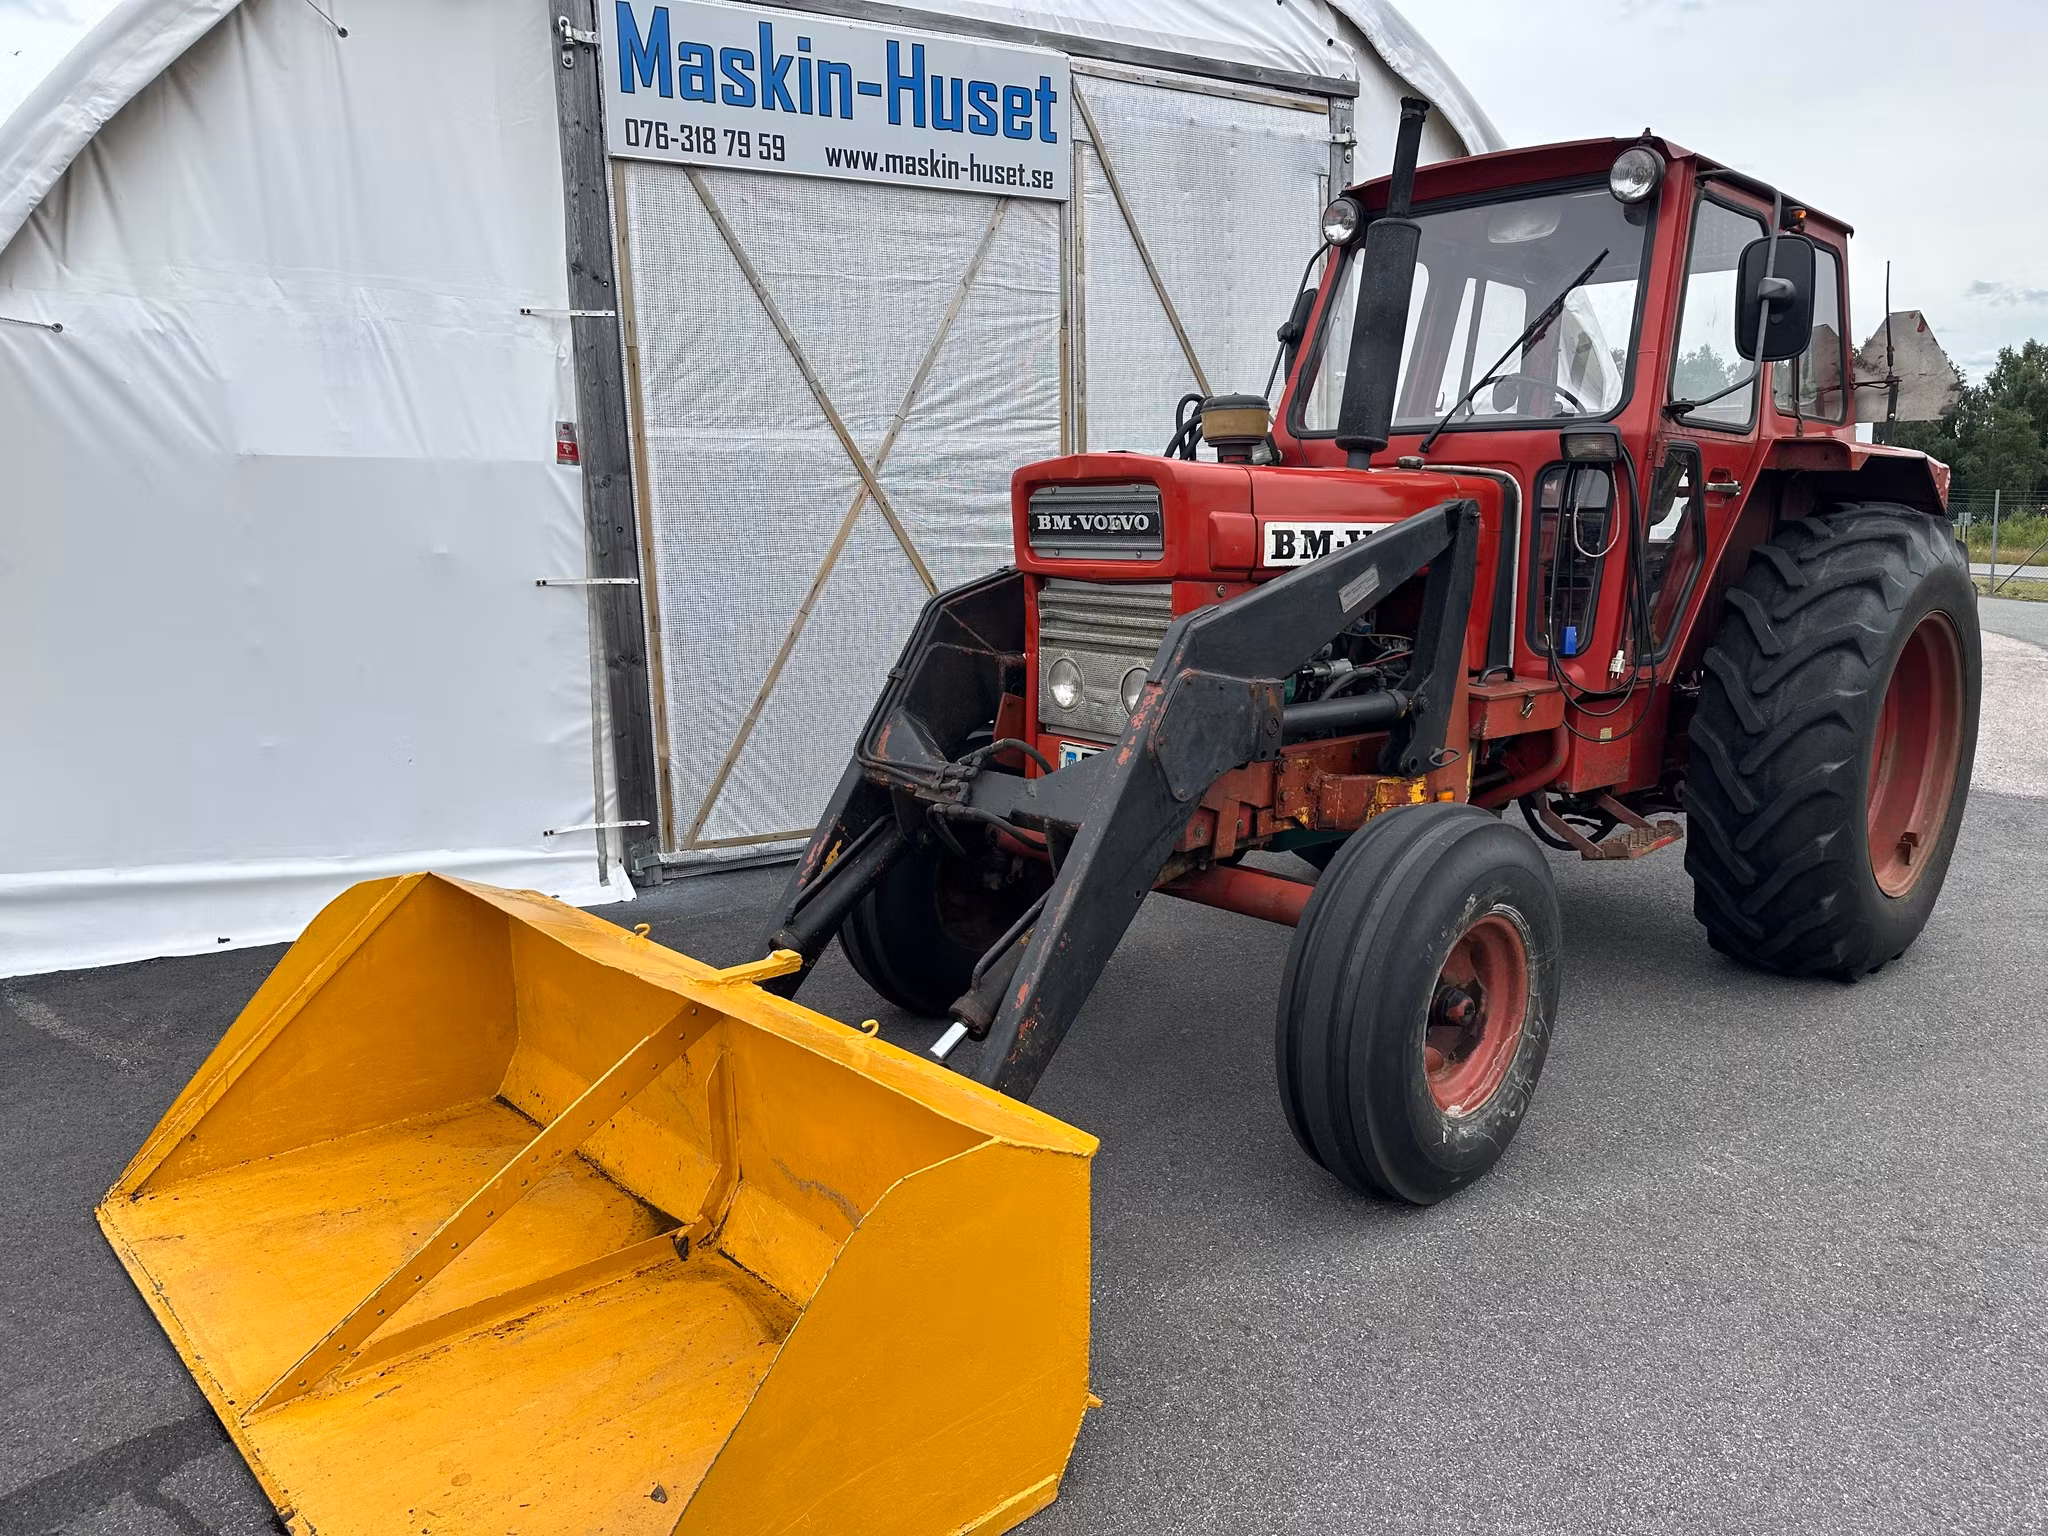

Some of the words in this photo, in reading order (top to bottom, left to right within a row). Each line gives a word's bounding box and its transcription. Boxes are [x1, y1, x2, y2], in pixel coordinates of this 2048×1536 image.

[614, 0, 1058, 145] Maskin-Huset
[624, 118, 716, 156] 076-318
[723, 129, 750, 159] 79
[759, 133, 786, 162] 59
[825, 147, 1054, 190] www.maskin-huset.se
